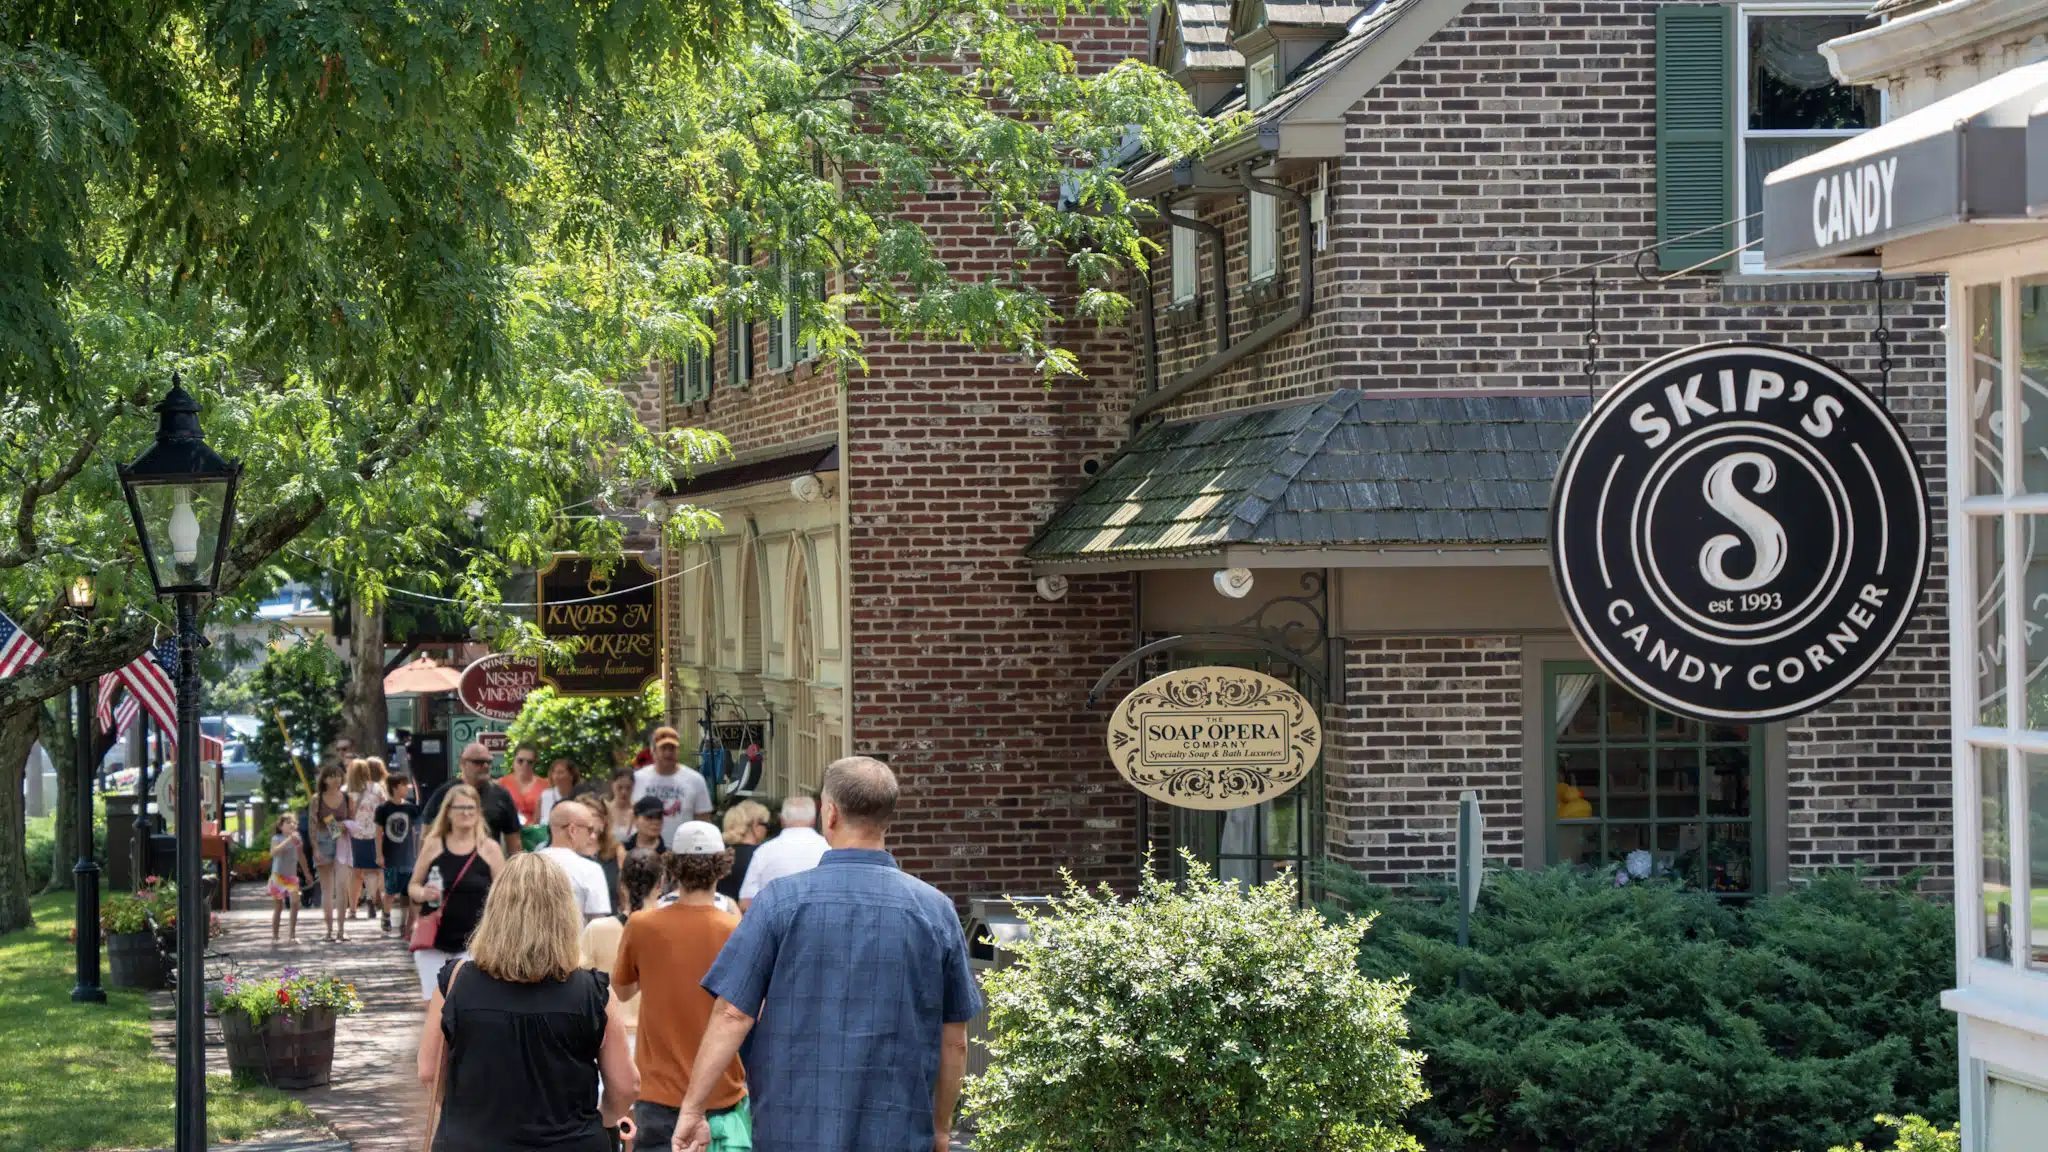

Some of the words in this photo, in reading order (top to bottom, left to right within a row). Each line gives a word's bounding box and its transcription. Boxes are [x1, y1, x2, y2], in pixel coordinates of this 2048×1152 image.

[1813, 156, 1897, 247] CANDY
[1629, 368, 1845, 449] SKIP'S
[1708, 596, 1733, 613] est
[1740, 592, 1783, 611] 1993
[547, 604, 617, 631] KNOBS
[1607, 599, 1732, 690] CANDY
[1747, 582, 1889, 691] CORNER
[479, 655, 511, 671] WINE
[513, 656, 537, 667] SHO
[485, 671, 537, 687] NISSLEY
[475, 701, 516, 718] TASTING
[1148, 724, 1203, 741] SOAP
[1207, 723, 1280, 740] OPERA
[1183, 740, 1247, 749] COMPANY
[1148, 750, 1186, 760] Specialty
[1189, 750, 1210, 759] Soap
[1244, 749, 1282, 757] Luxuries
